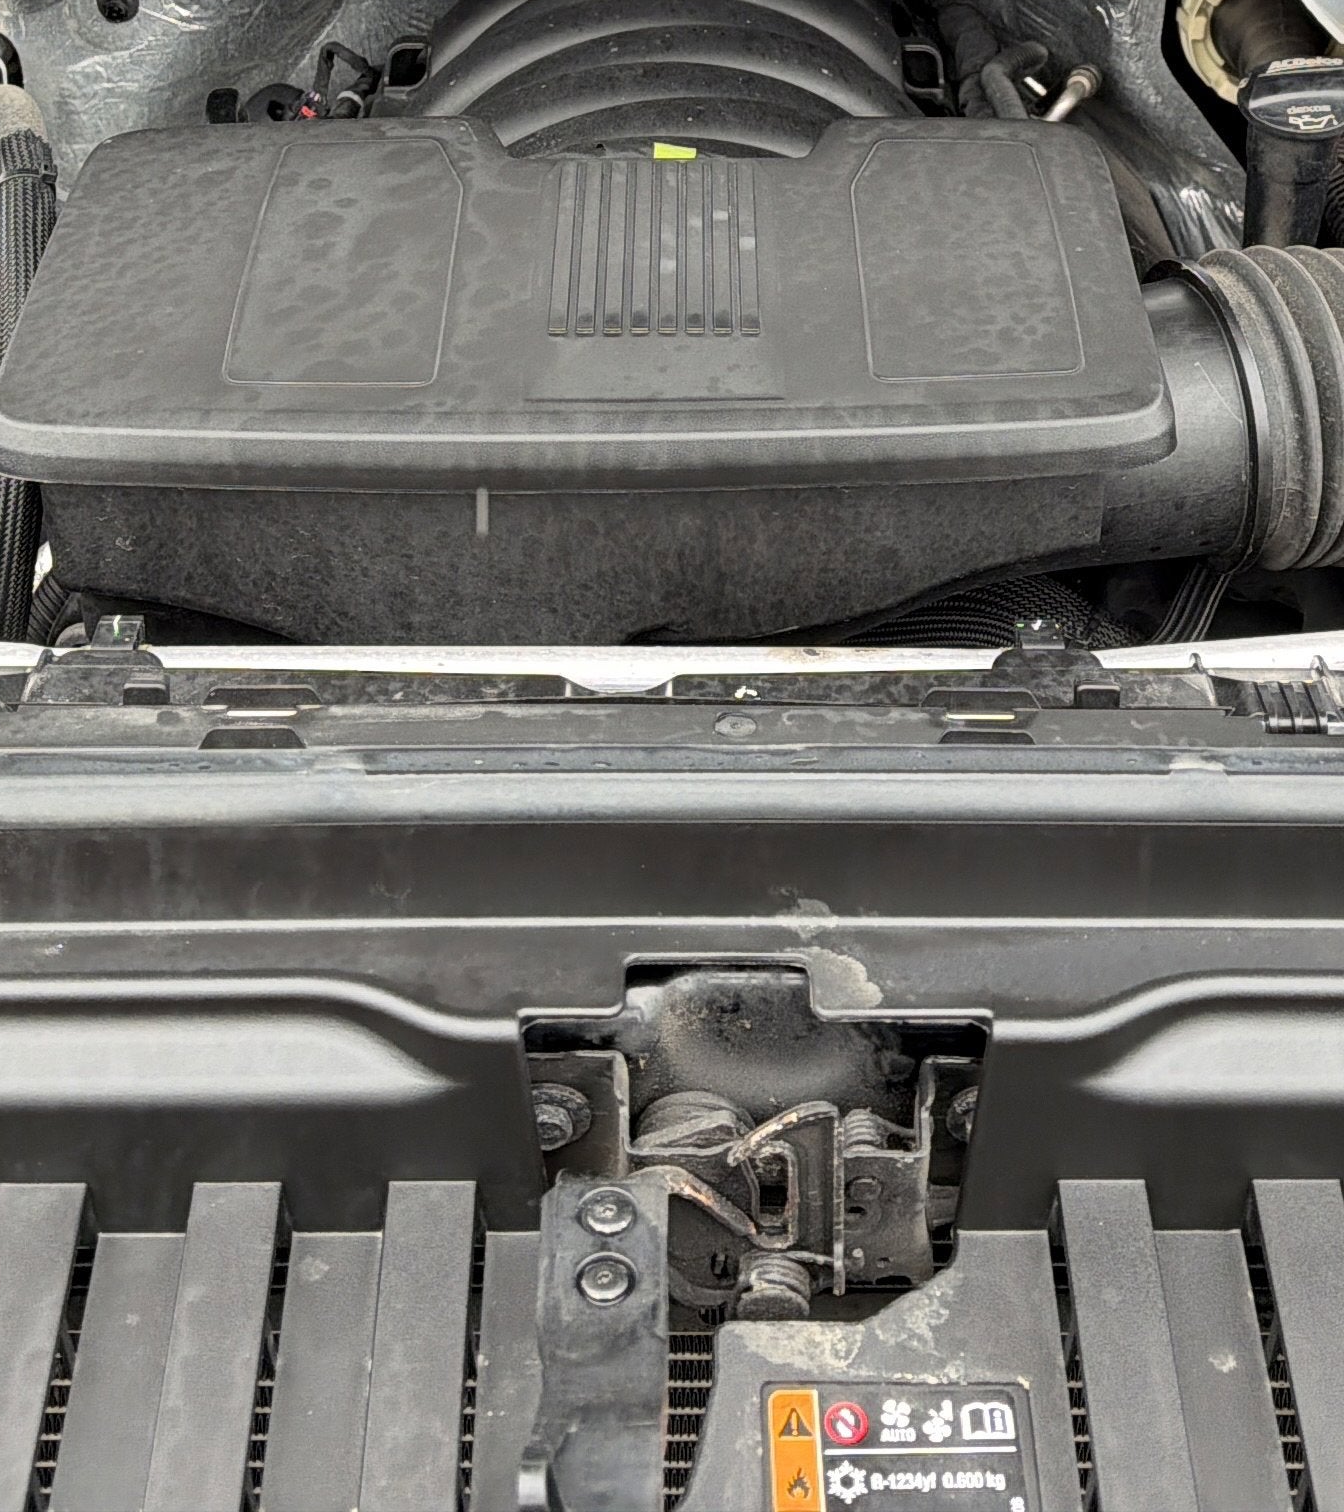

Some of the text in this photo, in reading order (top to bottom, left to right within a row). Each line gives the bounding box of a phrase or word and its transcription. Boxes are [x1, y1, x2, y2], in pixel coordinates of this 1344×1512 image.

[879, 1427, 917, 1443] AUTO
[869, 1470, 1006, 1493] R-1234yf 0.600 kg
